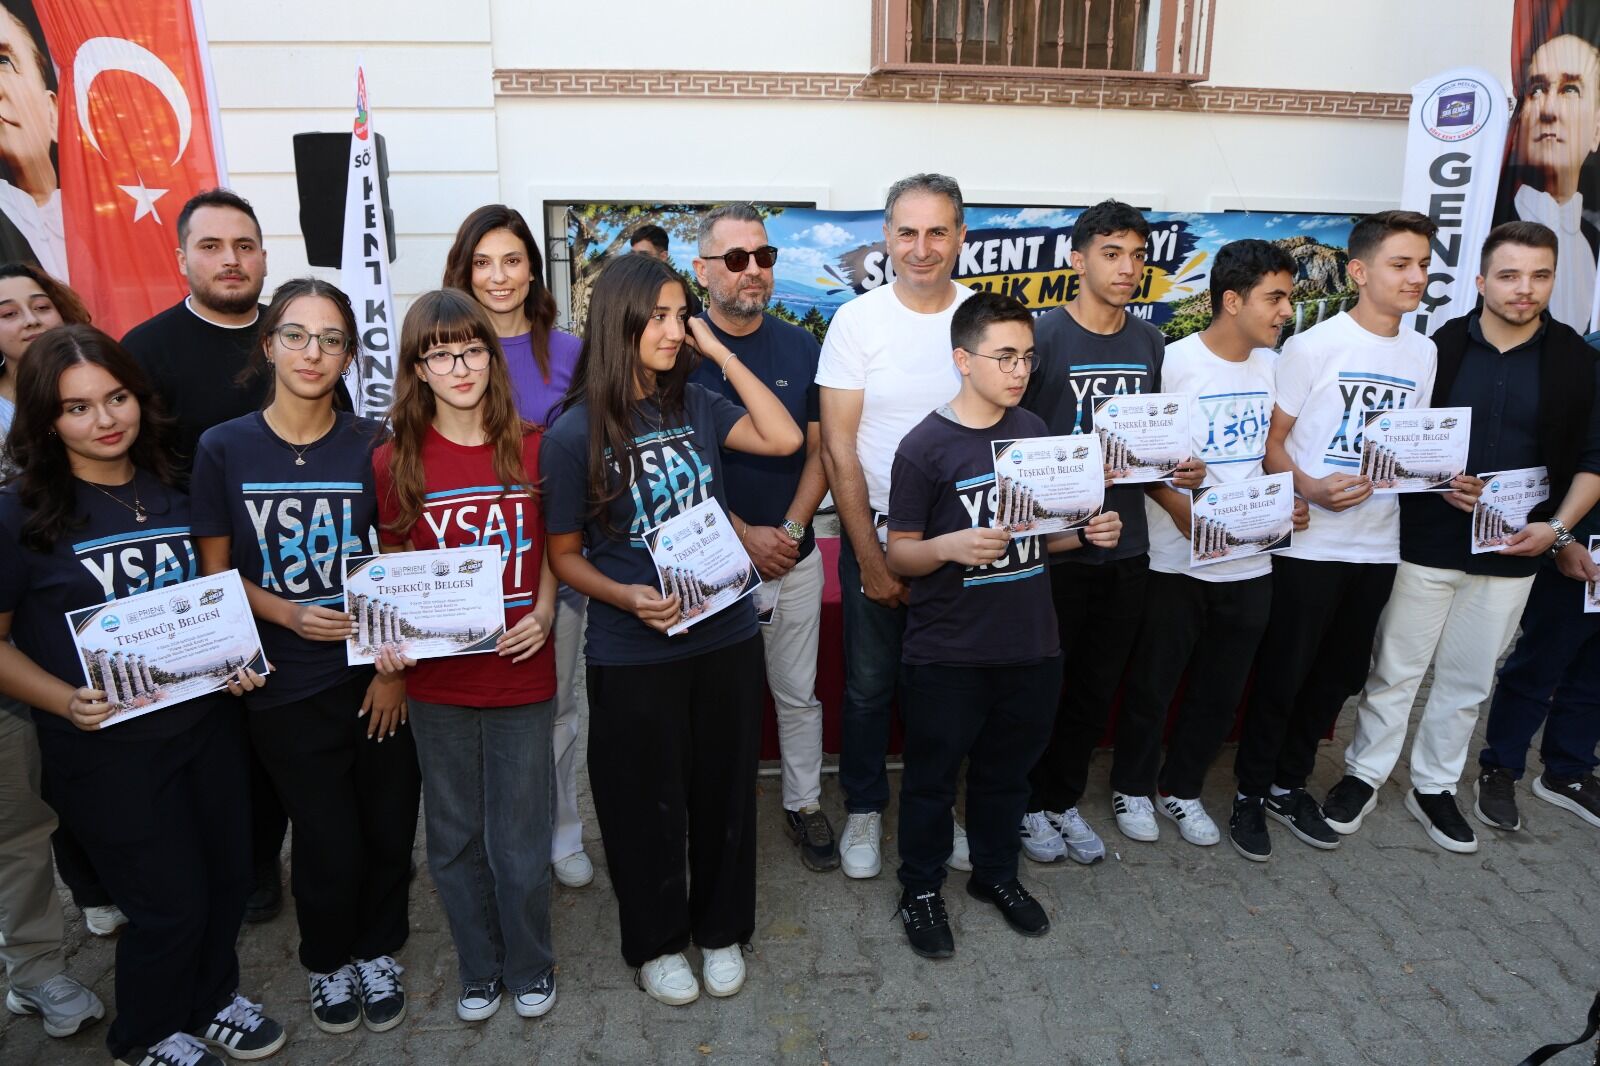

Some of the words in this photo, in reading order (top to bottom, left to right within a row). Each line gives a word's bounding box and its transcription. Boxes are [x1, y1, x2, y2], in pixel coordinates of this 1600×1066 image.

[354, 149, 371, 168] SÖ
[959, 235, 1043, 276] KENT
[1016, 466, 1056, 478] TEŞEKKÜR
[1057, 464, 1084, 474] BELGESİ
[377, 582, 431, 596] TEŞEKKÜR
[435, 577, 474, 590] BELGESİ
[114, 622, 175, 646] TEŞEKKÜR
[178, 608, 220, 629] BELGESİ
